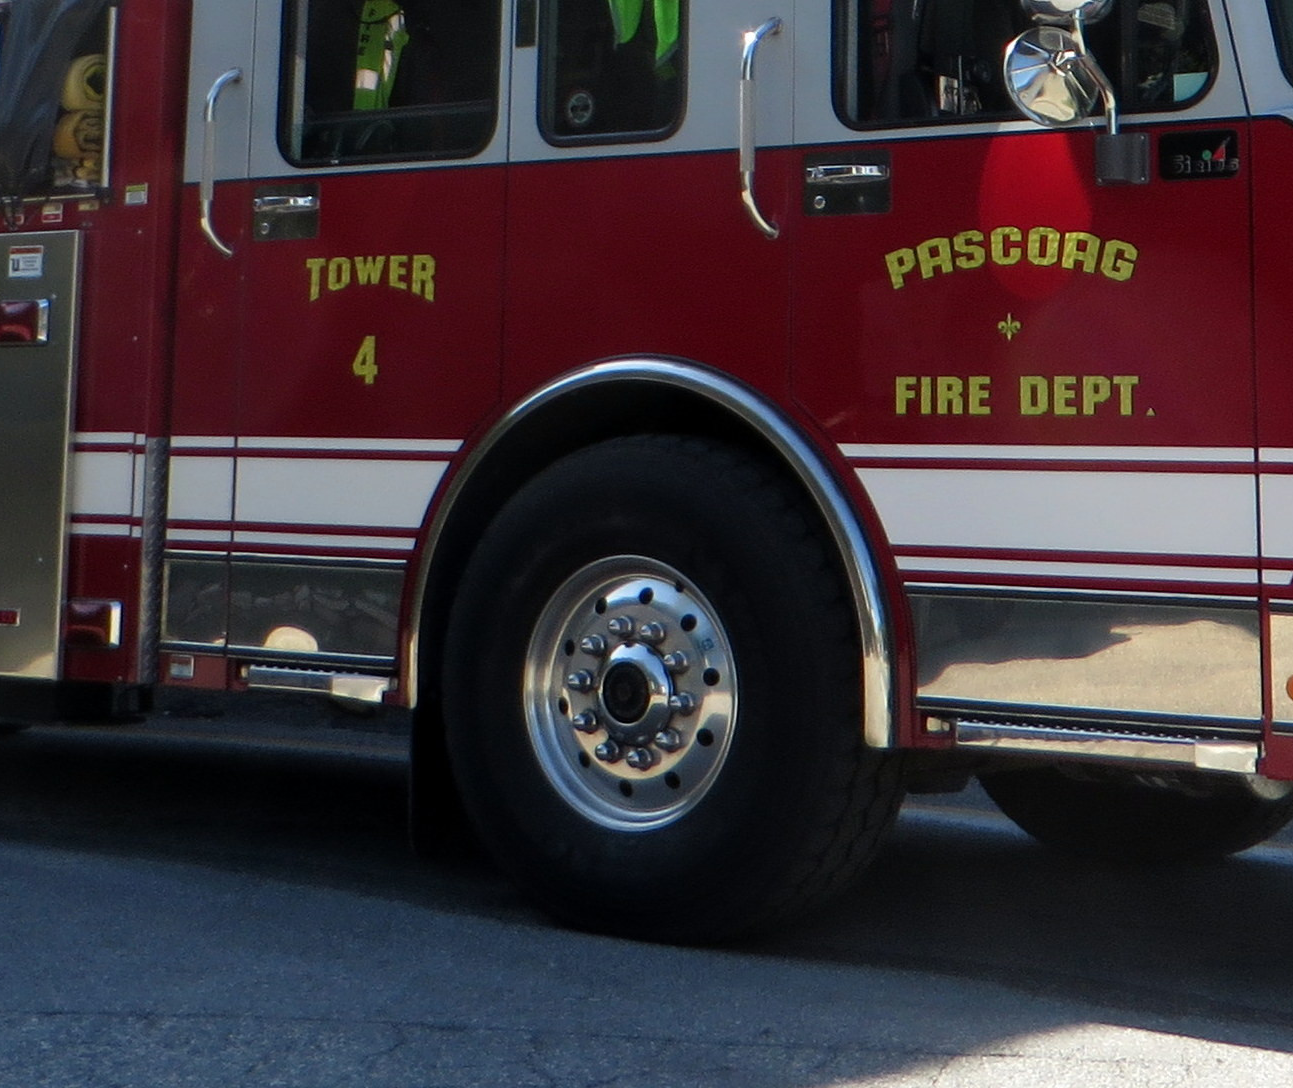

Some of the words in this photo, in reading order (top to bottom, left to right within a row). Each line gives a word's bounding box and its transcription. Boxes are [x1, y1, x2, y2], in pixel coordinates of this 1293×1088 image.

[306, 254, 436, 303] TOWER
[884, 226, 1139, 290] PASCOAG
[352, 335, 379, 385] 4
[895, 375, 992, 416] FIRE
[1019, 375, 1156, 416] DEPT.
